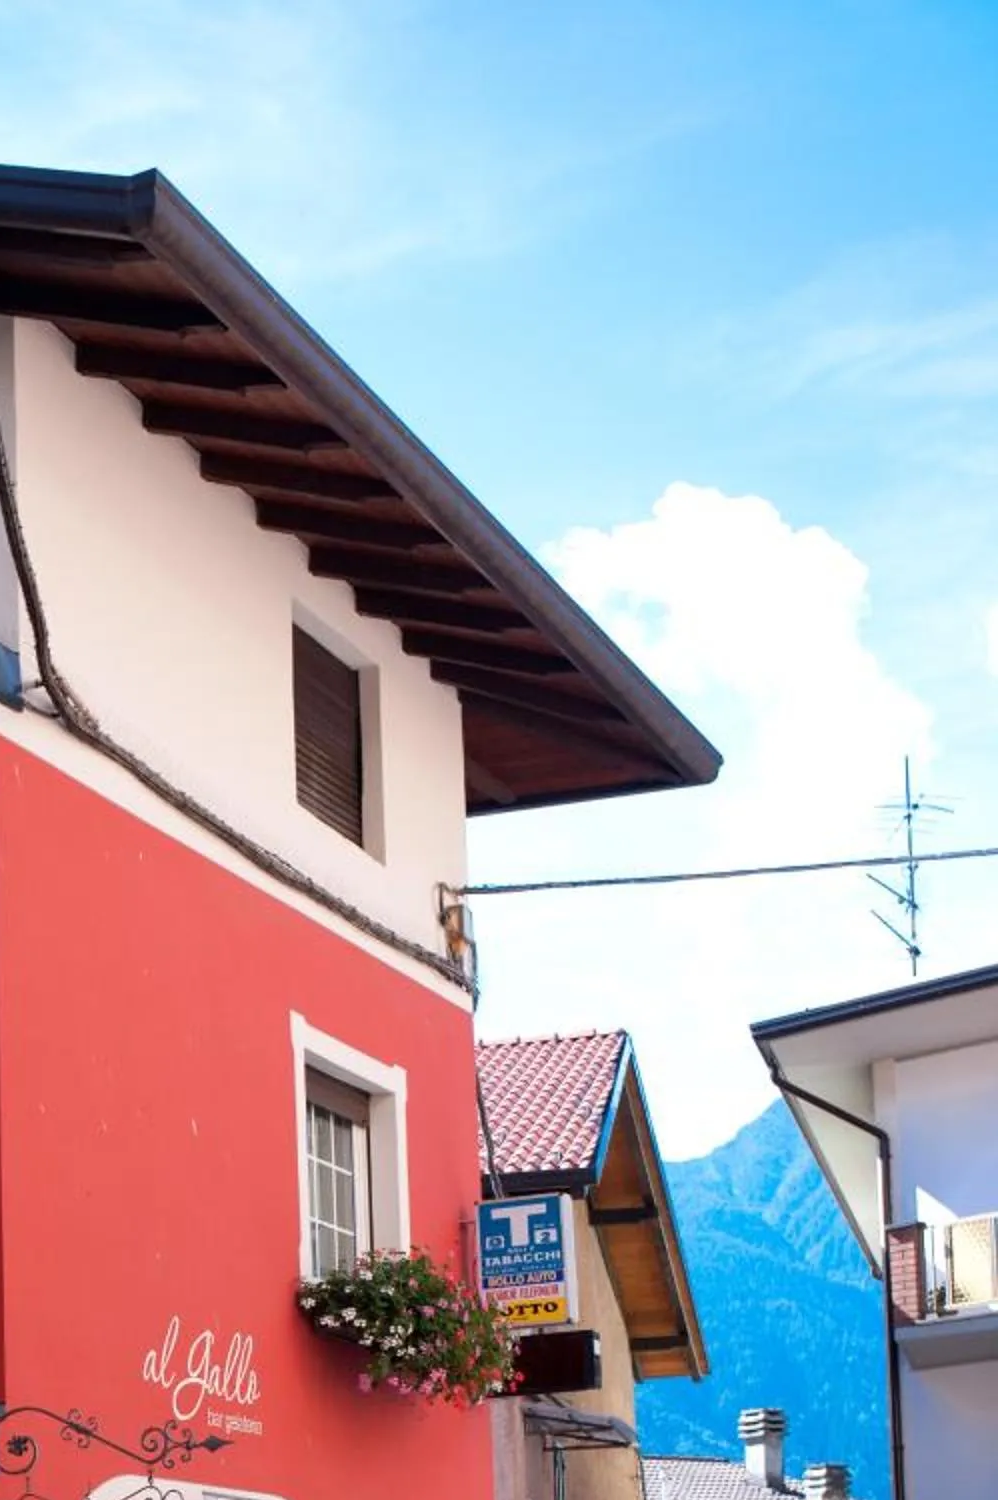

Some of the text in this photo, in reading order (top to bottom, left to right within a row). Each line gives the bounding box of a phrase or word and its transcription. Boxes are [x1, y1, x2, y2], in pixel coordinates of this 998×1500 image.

[491, 1203, 546, 1247] T
[485, 1250, 561, 1266] TABACCHI
[527, 1270, 557, 1284] AUTO
[499, 1302, 558, 1316] OTTO
[142, 1315, 261, 1421] al Gallo
